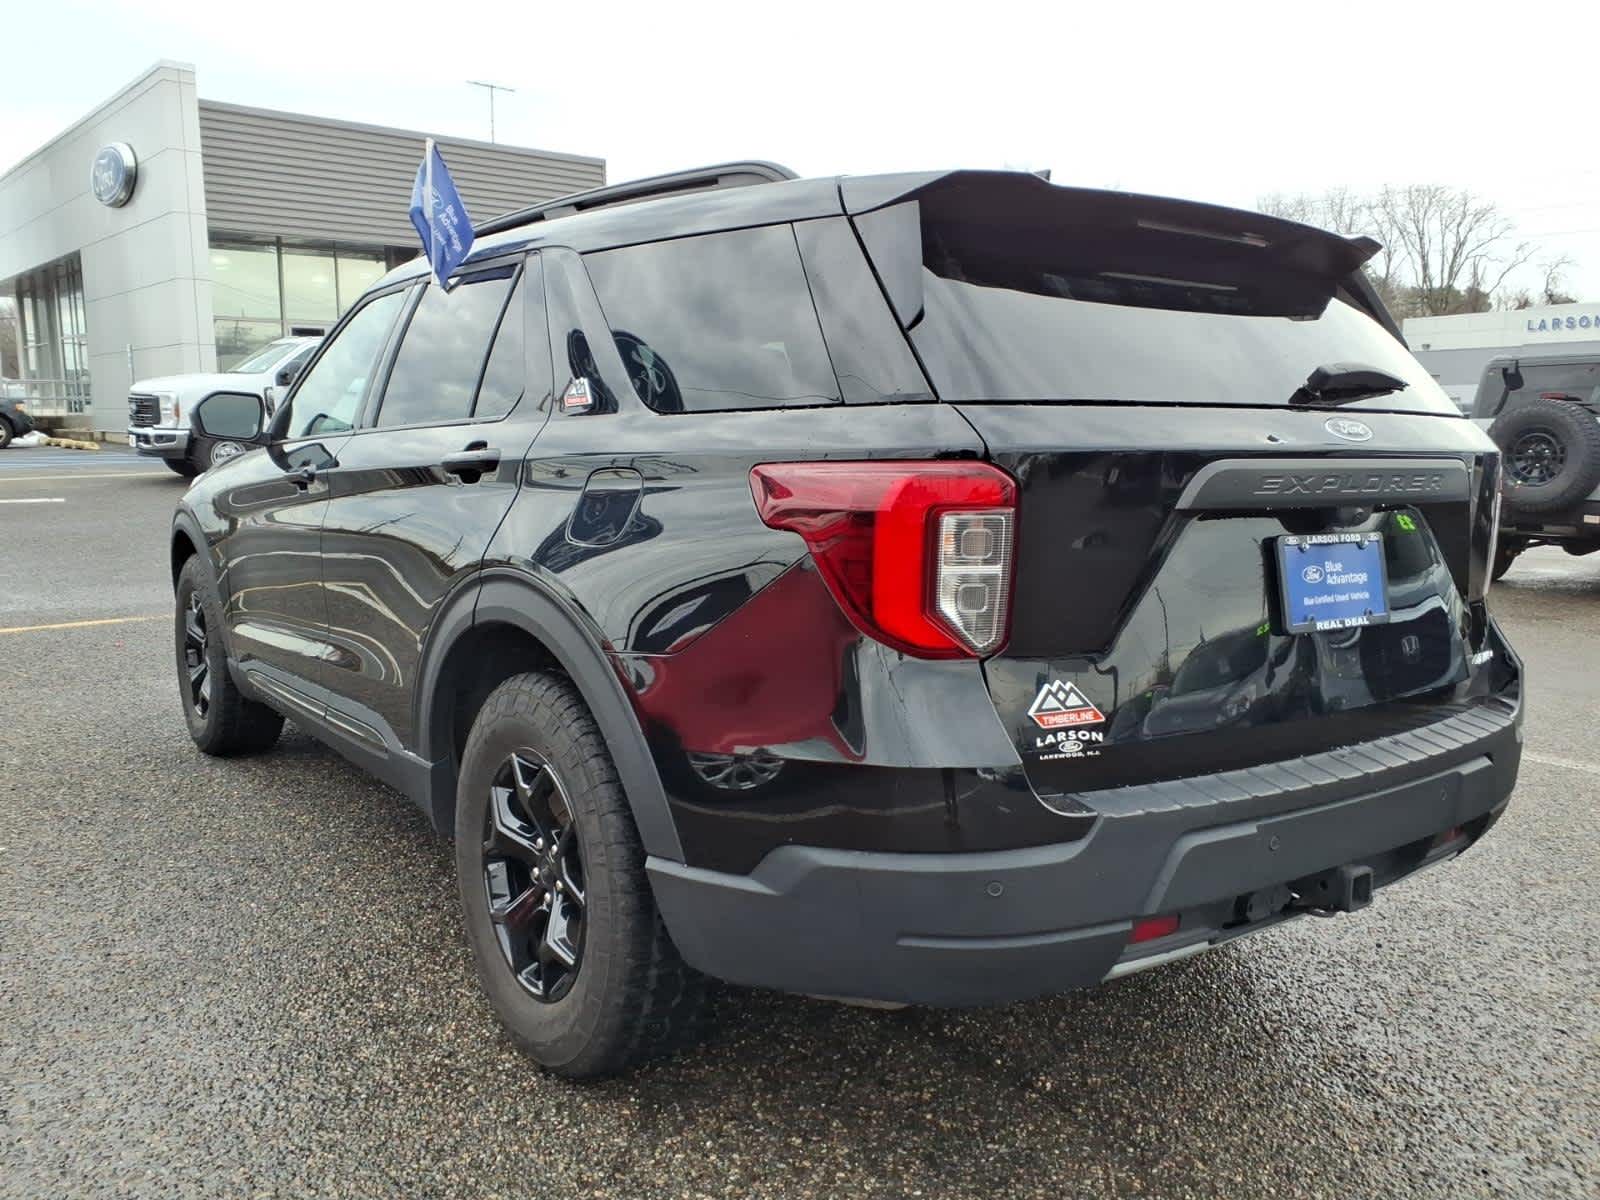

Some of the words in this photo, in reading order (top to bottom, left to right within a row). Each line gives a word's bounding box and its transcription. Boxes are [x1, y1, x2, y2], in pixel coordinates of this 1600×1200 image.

[1253, 474, 1444, 495] EXPLORER
[1306, 535, 1339, 545] LARSON
[1340, 533, 1361, 544] FORD
[1324, 560, 1343, 572] Blue
[1326, 571, 1368, 585] Advantage
[1316, 619, 1343, 631] REAL
[1344, 616, 1370, 628] DEAL
[1043, 711, 1094, 725] TIMBERLINE
[1036, 730, 1104, 748] LARSON
